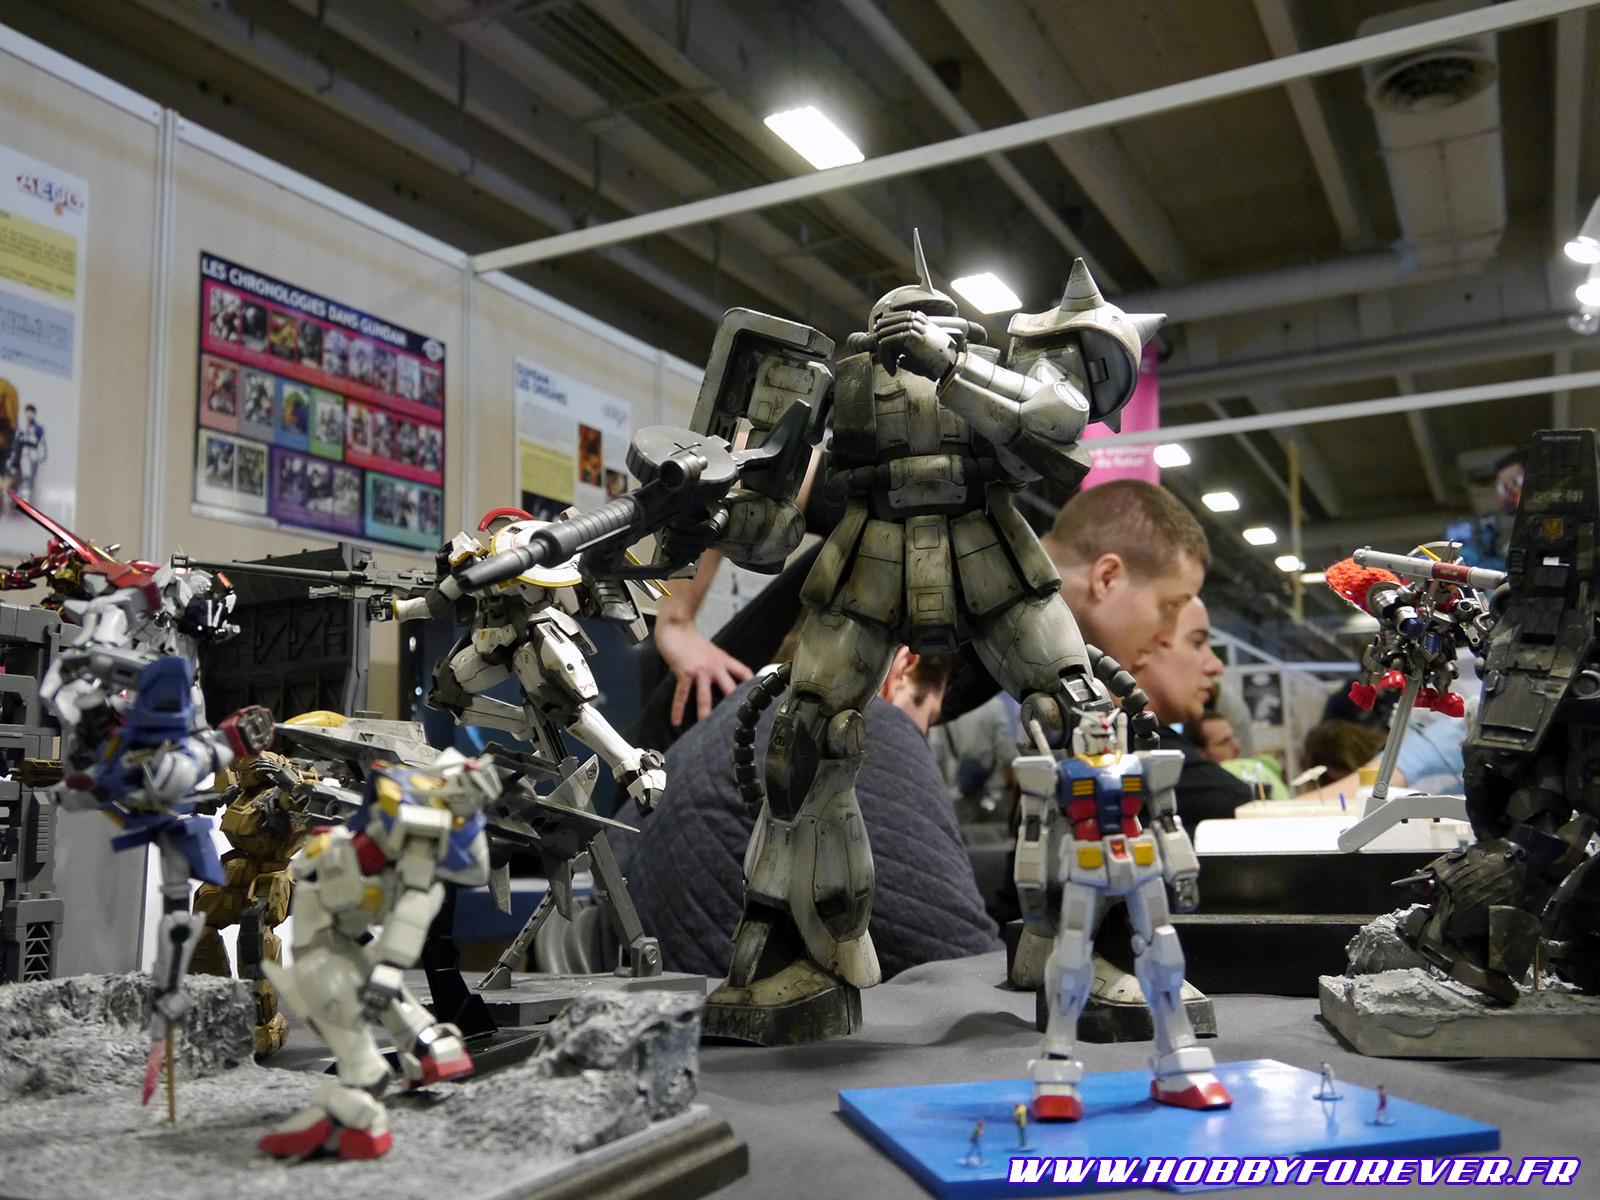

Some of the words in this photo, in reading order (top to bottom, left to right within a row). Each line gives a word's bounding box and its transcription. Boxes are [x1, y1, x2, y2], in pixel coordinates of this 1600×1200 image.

[202, 257, 227, 280] LES
[229, 267, 327, 318] CHRONOLOGIES
[328, 304, 359, 330] DANS
[360, 317, 407, 347] GUNDAM
